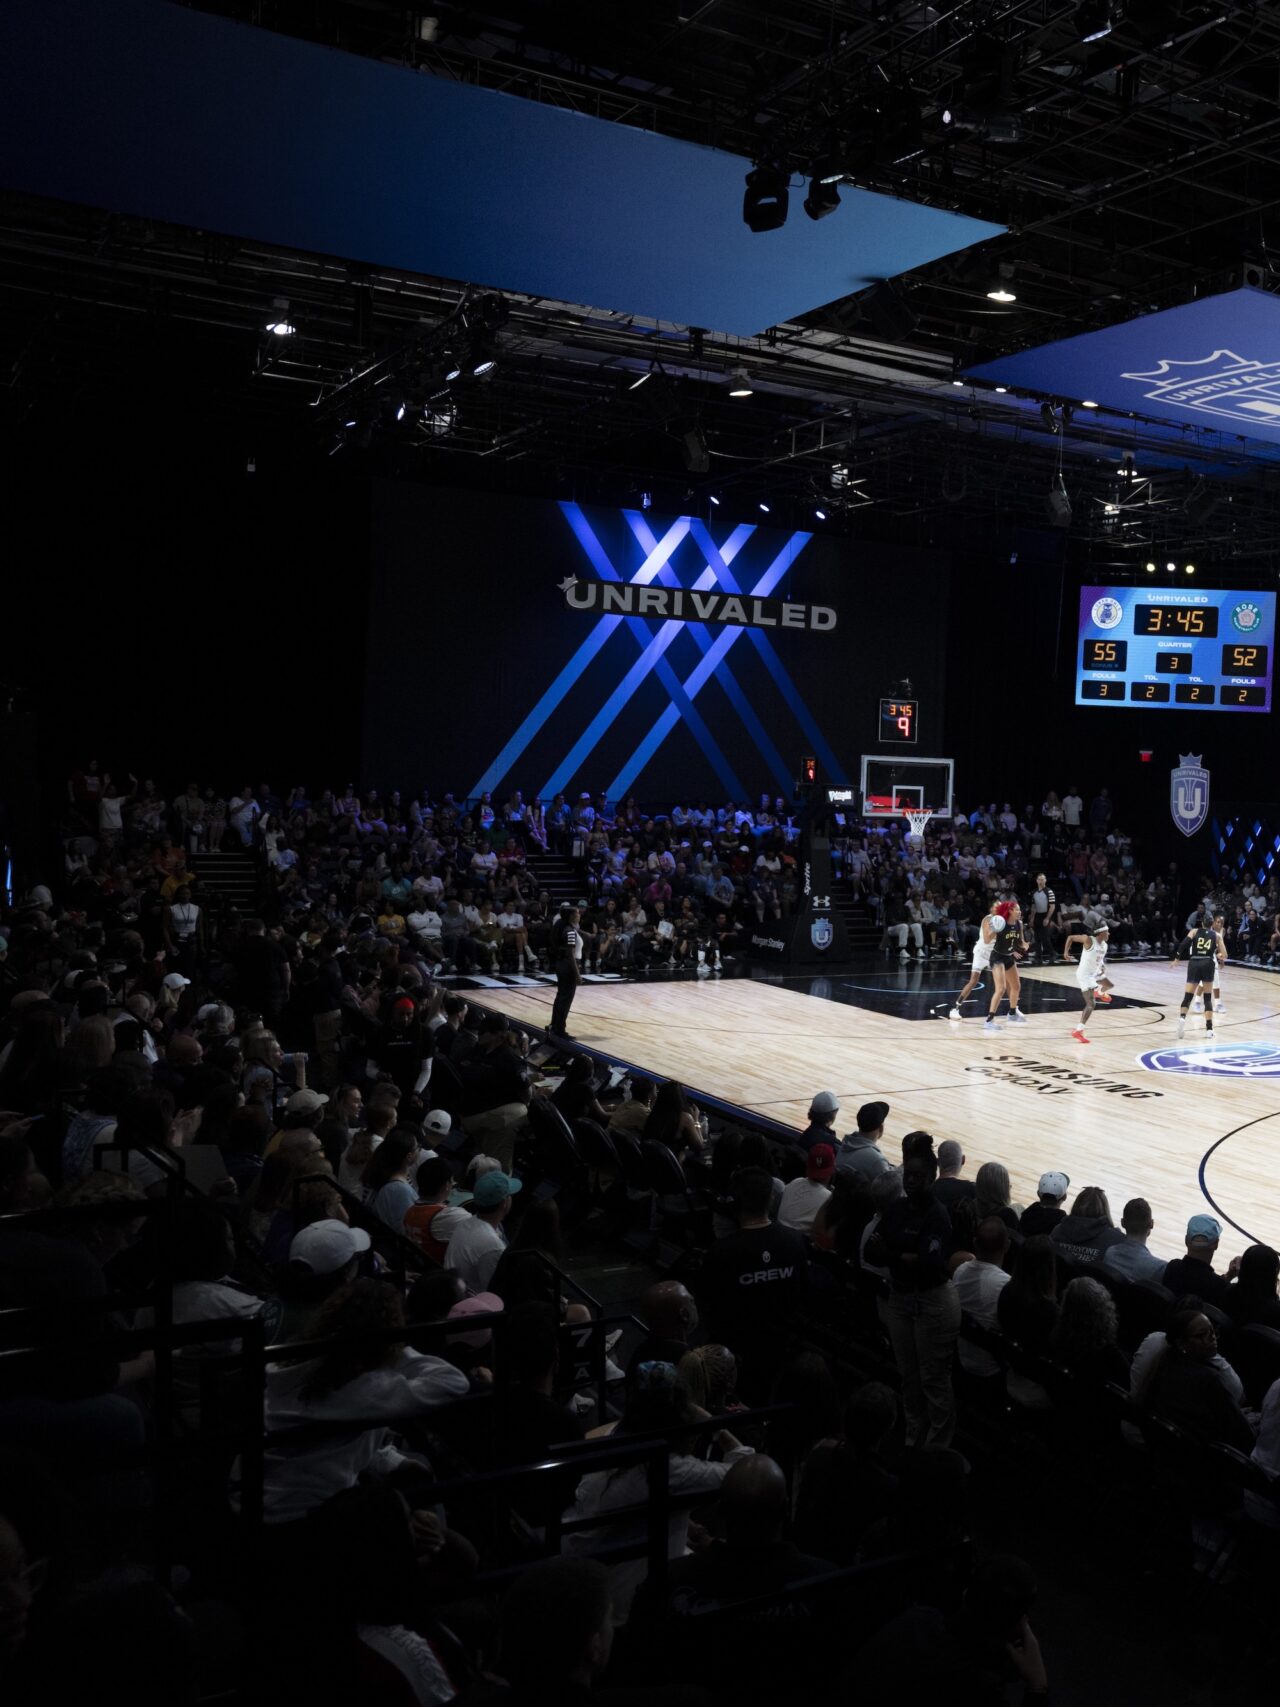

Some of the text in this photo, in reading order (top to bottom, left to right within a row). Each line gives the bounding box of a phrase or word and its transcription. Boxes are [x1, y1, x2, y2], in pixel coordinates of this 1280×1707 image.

[565, 580, 838, 632] UNRIVALED
[1147, 593, 1208, 603] UNRIVALED
[1236, 604, 1258, 613] ROSE
[1147, 609, 1204, 632] 3:45
[1094, 642, 1116, 661] 55
[1158, 641, 1192, 649] QUARTER
[1170, 657, 1178, 669] 3
[1232, 648, 1257, 666] 52
[1100, 684, 1248, 702] 3 2 2 2
[898, 716, 910, 737] 9
[1177, 787, 1202, 819] U
[1196, 937, 1212, 950] 24
[964, 1065, 1075, 1095] Galaxy
[983, 1055, 1164, 1099] SAMSUNG
[738, 1266, 794, 1286] CREW
